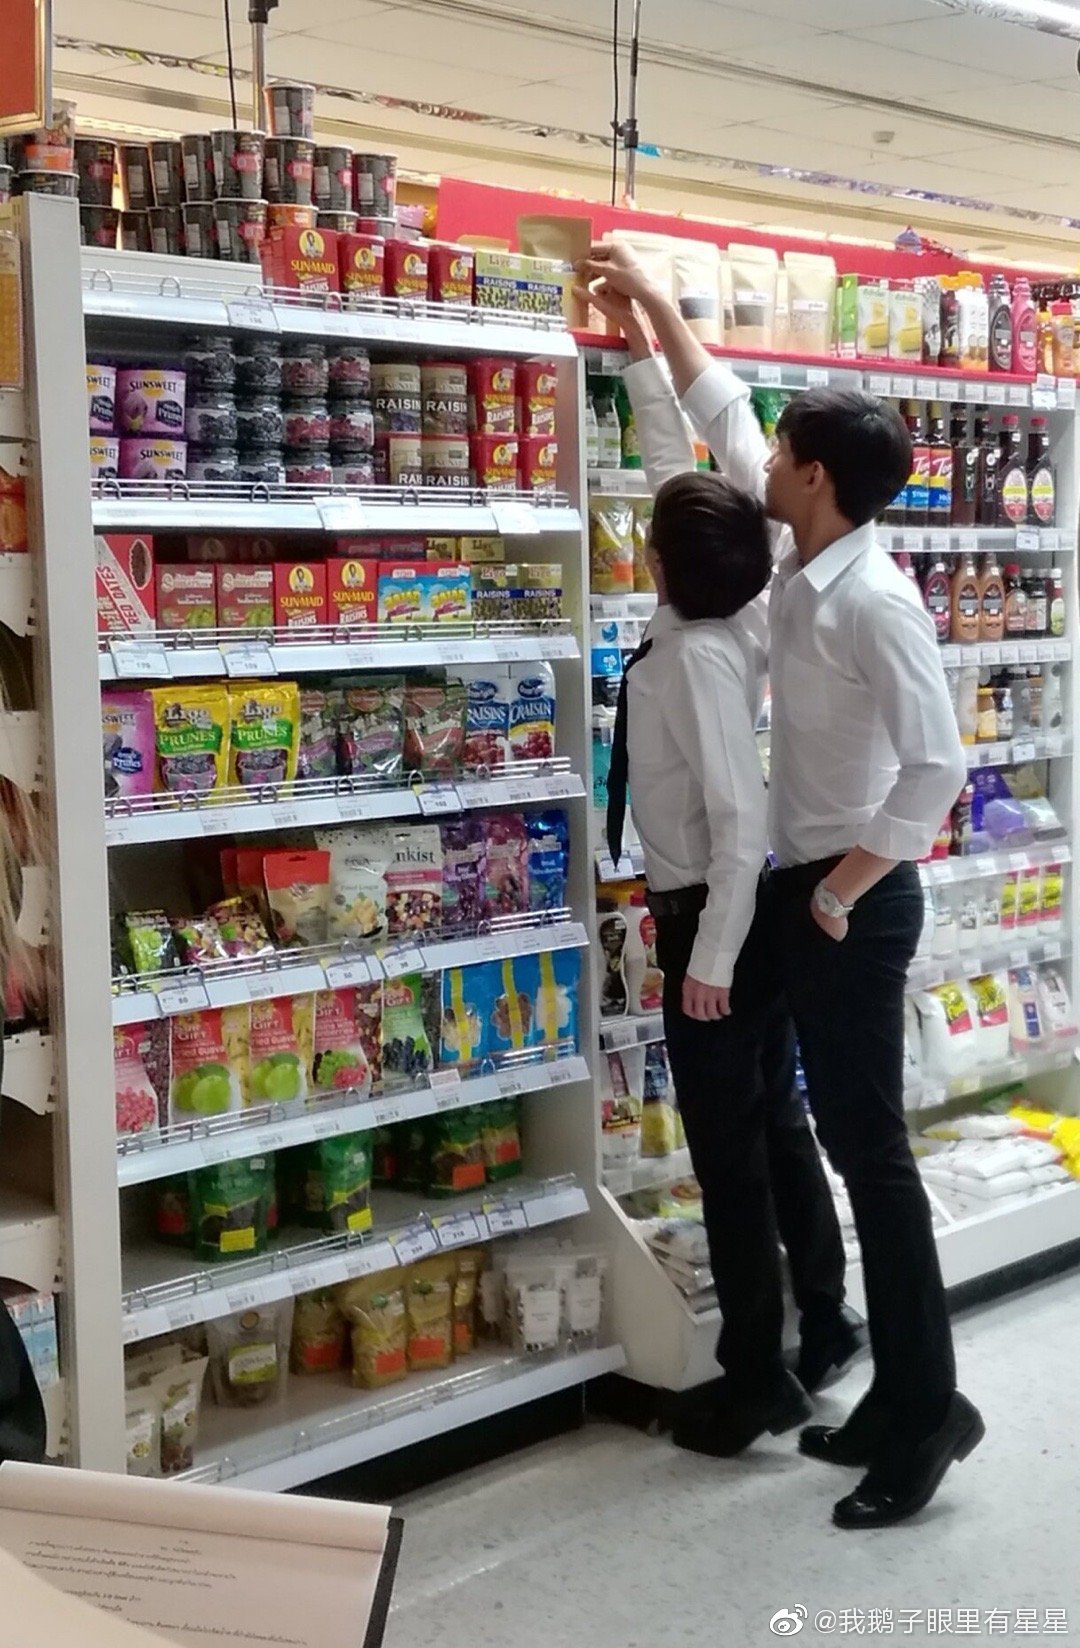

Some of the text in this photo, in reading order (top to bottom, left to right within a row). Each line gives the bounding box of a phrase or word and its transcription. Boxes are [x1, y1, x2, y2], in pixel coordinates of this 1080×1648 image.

[129, 380, 177, 394] SUNSWEET
[476, 590, 511, 599] RAISINS
[523, 589, 557, 598] RAISINS
[159, 730, 217, 747] PRUNES
[237, 726, 289, 742] PRUNES
